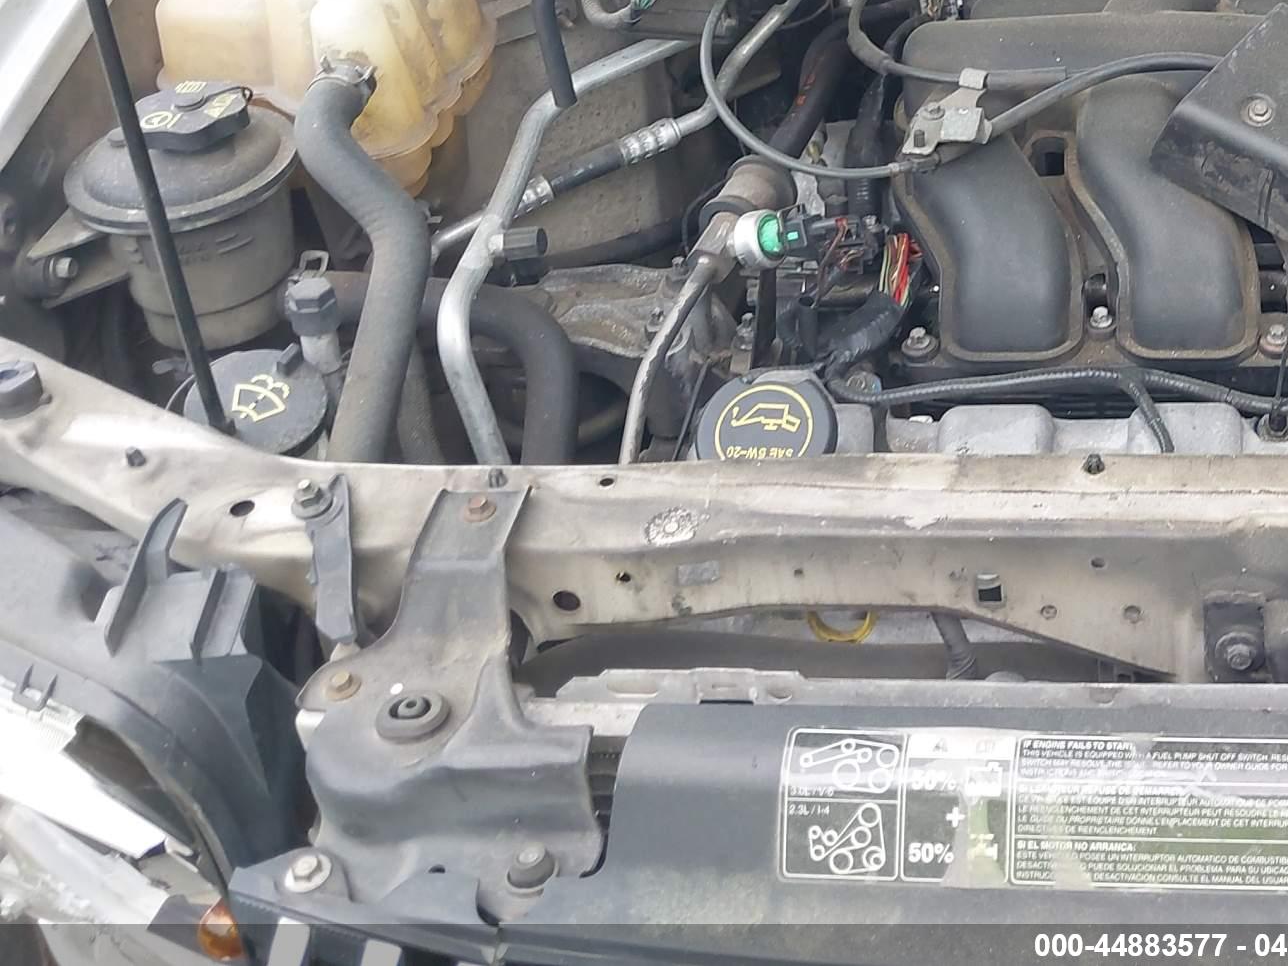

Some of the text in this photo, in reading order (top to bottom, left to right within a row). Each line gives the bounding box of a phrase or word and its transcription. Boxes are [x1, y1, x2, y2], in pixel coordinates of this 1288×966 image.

[1033, 740, 1066, 750] ENGINE
[1067, 741, 1092, 750] FAILS
[1092, 741, 1105, 750] TO
[1023, 750, 1039, 758] THIS
[1042, 750, 1073, 759] VEHICLE
[1084, 751, 1124, 760] EQUIPPED
[1152, 752, 1172, 760] FUEL
[1174, 752, 1197, 761] PUMP
[1198, 752, 1219, 761] SHUT
[1220, 753, 1237, 761] OFF
[1270, 762, 1287, 771] FOR
[788, 804, 810, 816] 2.3L
[1122, 807, 1138, 816] CET
[1140, 807, 1200, 817] INTERRUPTEUR
[1201, 808, 1222, 817] PEUT
[1233, 818, 1249, 827] CET
[1040, 841, 1072, 851] MOTOR
[1074, 842, 1088, 851] NO
[908, 842, 954, 864] 50%
[1018, 851, 1037, 859] ESTE
[1080, 852, 1106, 861] POSEE
[1107, 852, 1120, 861] UN
[1121, 852, 1176, 862] INTERRUPTOR
[1177, 854, 1227, 863] AUTOMATICO
[1088, 862, 1114, 871] PUEDE
[1116, 863, 1167, 872] SOLUCIONAR
[1226, 865, 1246, 874] PARA
[1094, 872, 1155, 882] DESACTIVACION
[1157, 873, 1198, 883] CONSULTE
[1212, 874, 1243, 884] MANUAL
[1246, 875, 1259, 884] DEL
